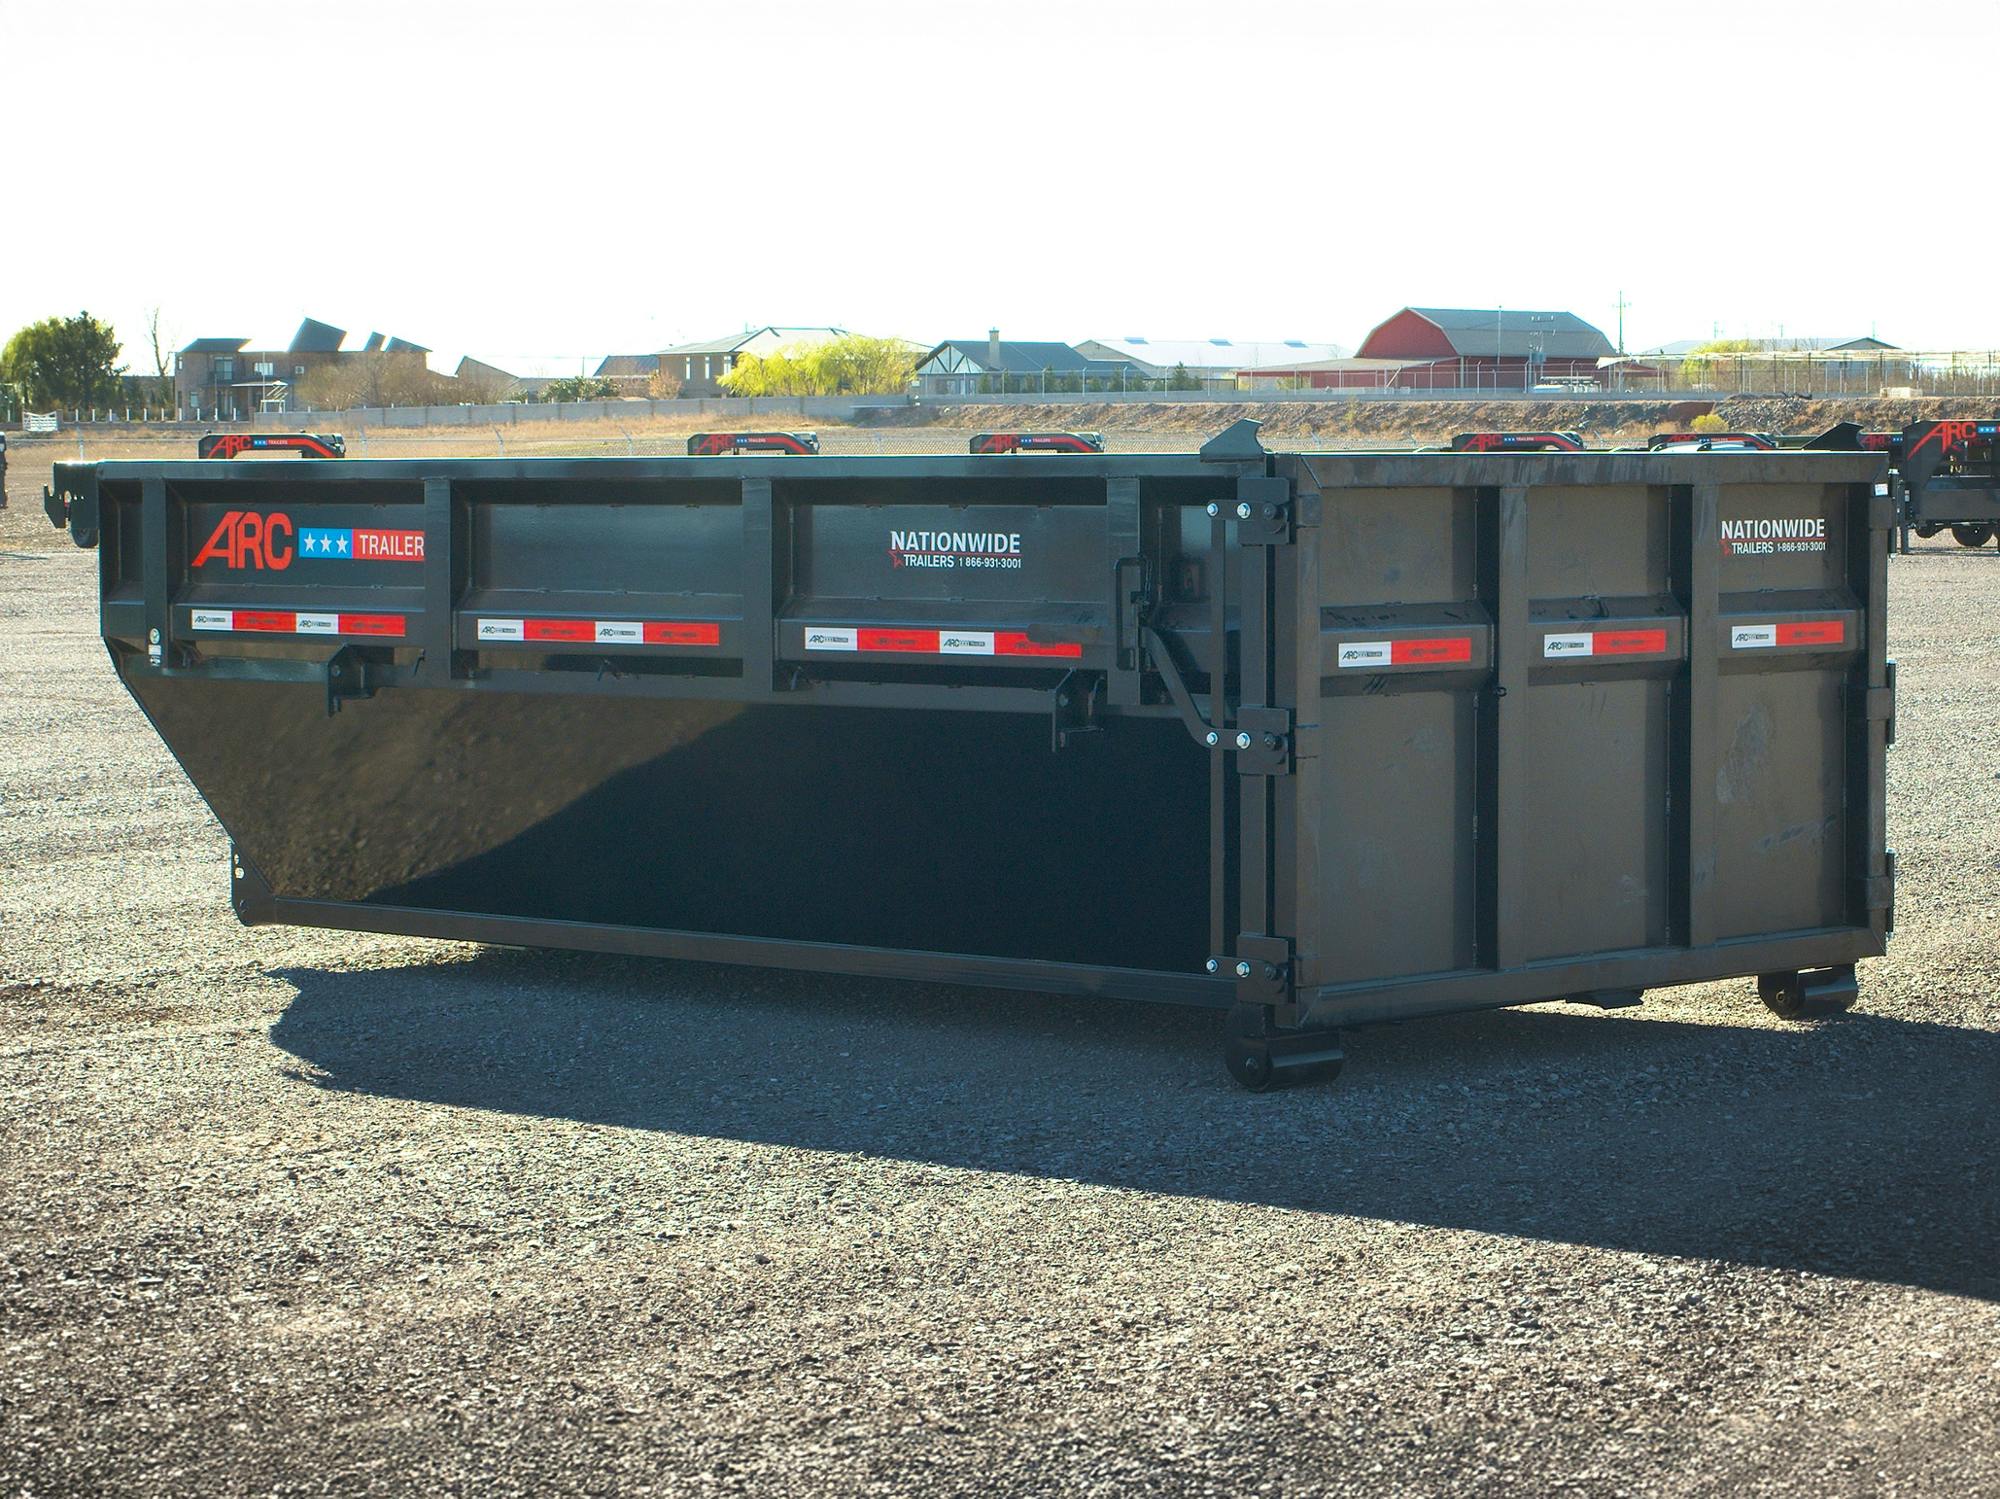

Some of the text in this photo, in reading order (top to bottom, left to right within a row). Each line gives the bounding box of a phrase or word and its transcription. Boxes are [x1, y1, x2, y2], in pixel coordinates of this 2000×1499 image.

[207, 434, 251, 459] ARC
[1906, 420, 1977, 460] ARC
[1721, 519, 1825, 539] NATIONWIDE
[191, 511, 425, 570] ARC TRAILER
[890, 531, 1020, 553] NATIONWIDE
[1732, 542, 1774, 554] TRAILERS
[903, 554, 955, 568] TRAILERS
